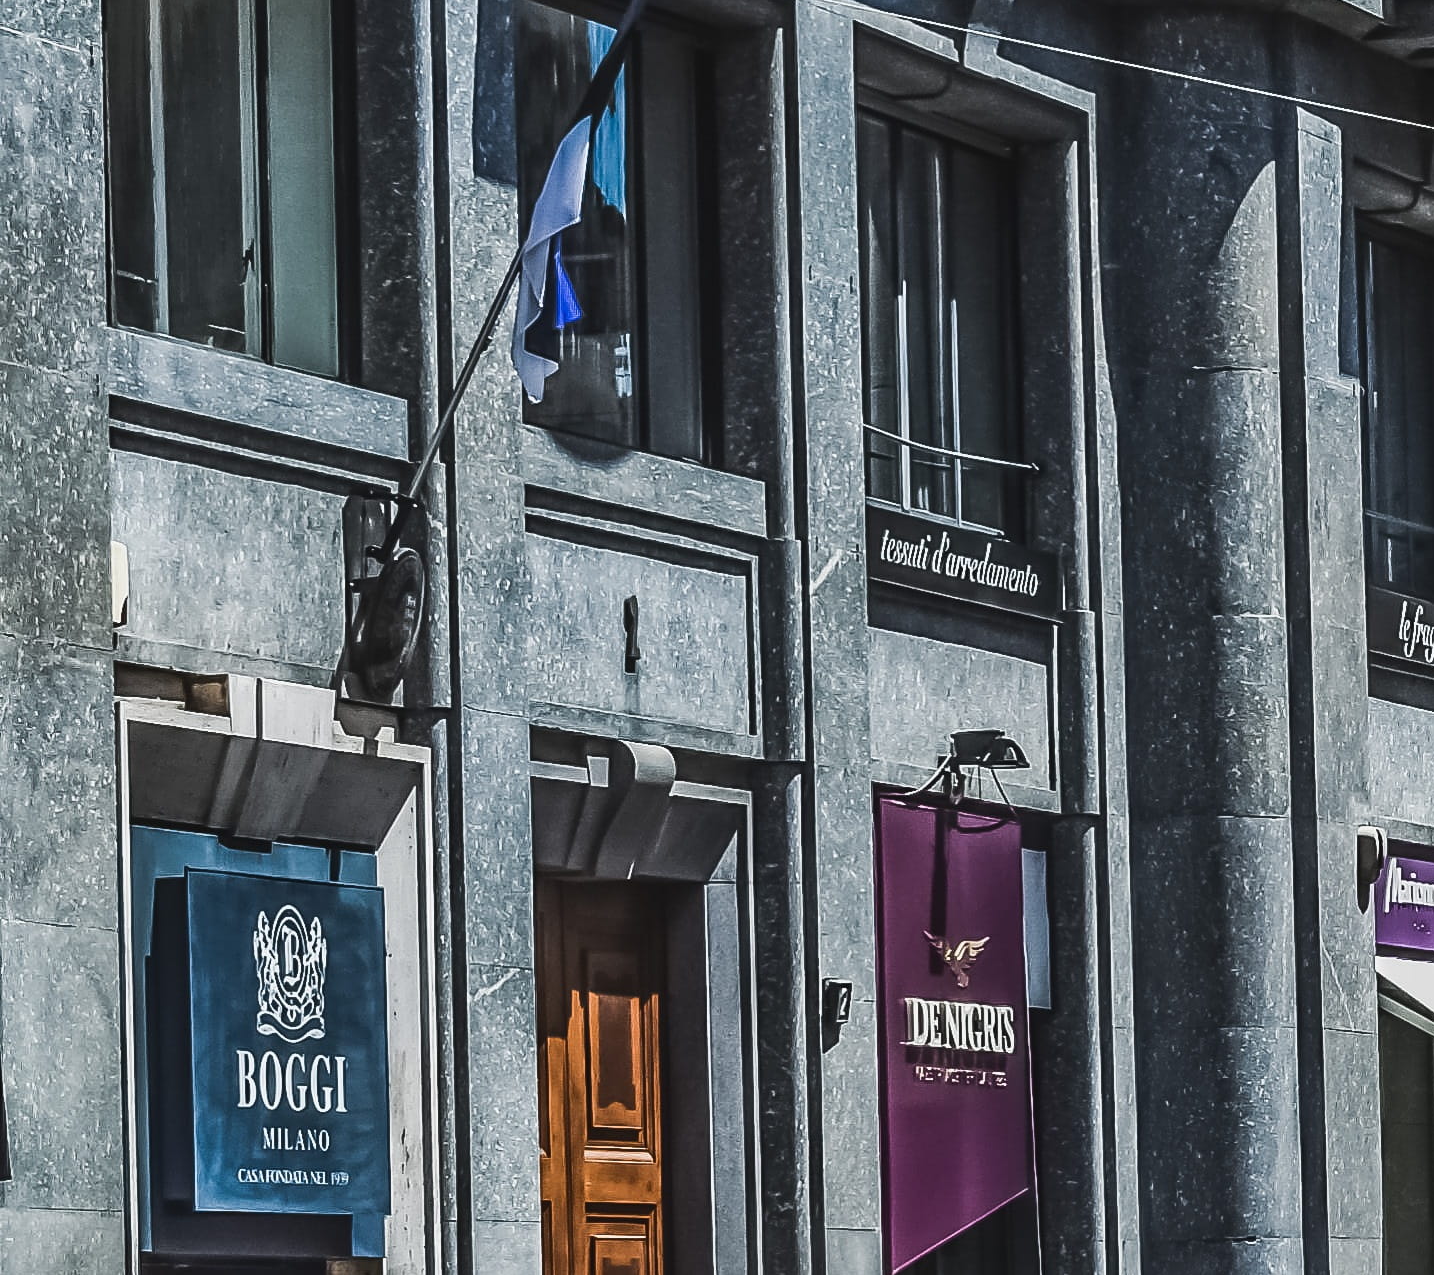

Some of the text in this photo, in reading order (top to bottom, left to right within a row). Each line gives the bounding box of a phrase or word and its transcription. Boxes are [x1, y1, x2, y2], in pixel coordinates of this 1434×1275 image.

[880, 529, 932, 570] tessuti
[1399, 600, 1411, 642] le
[236, 1049, 349, 1113] BOGGI
[262, 1127, 330, 1152] MILANO
